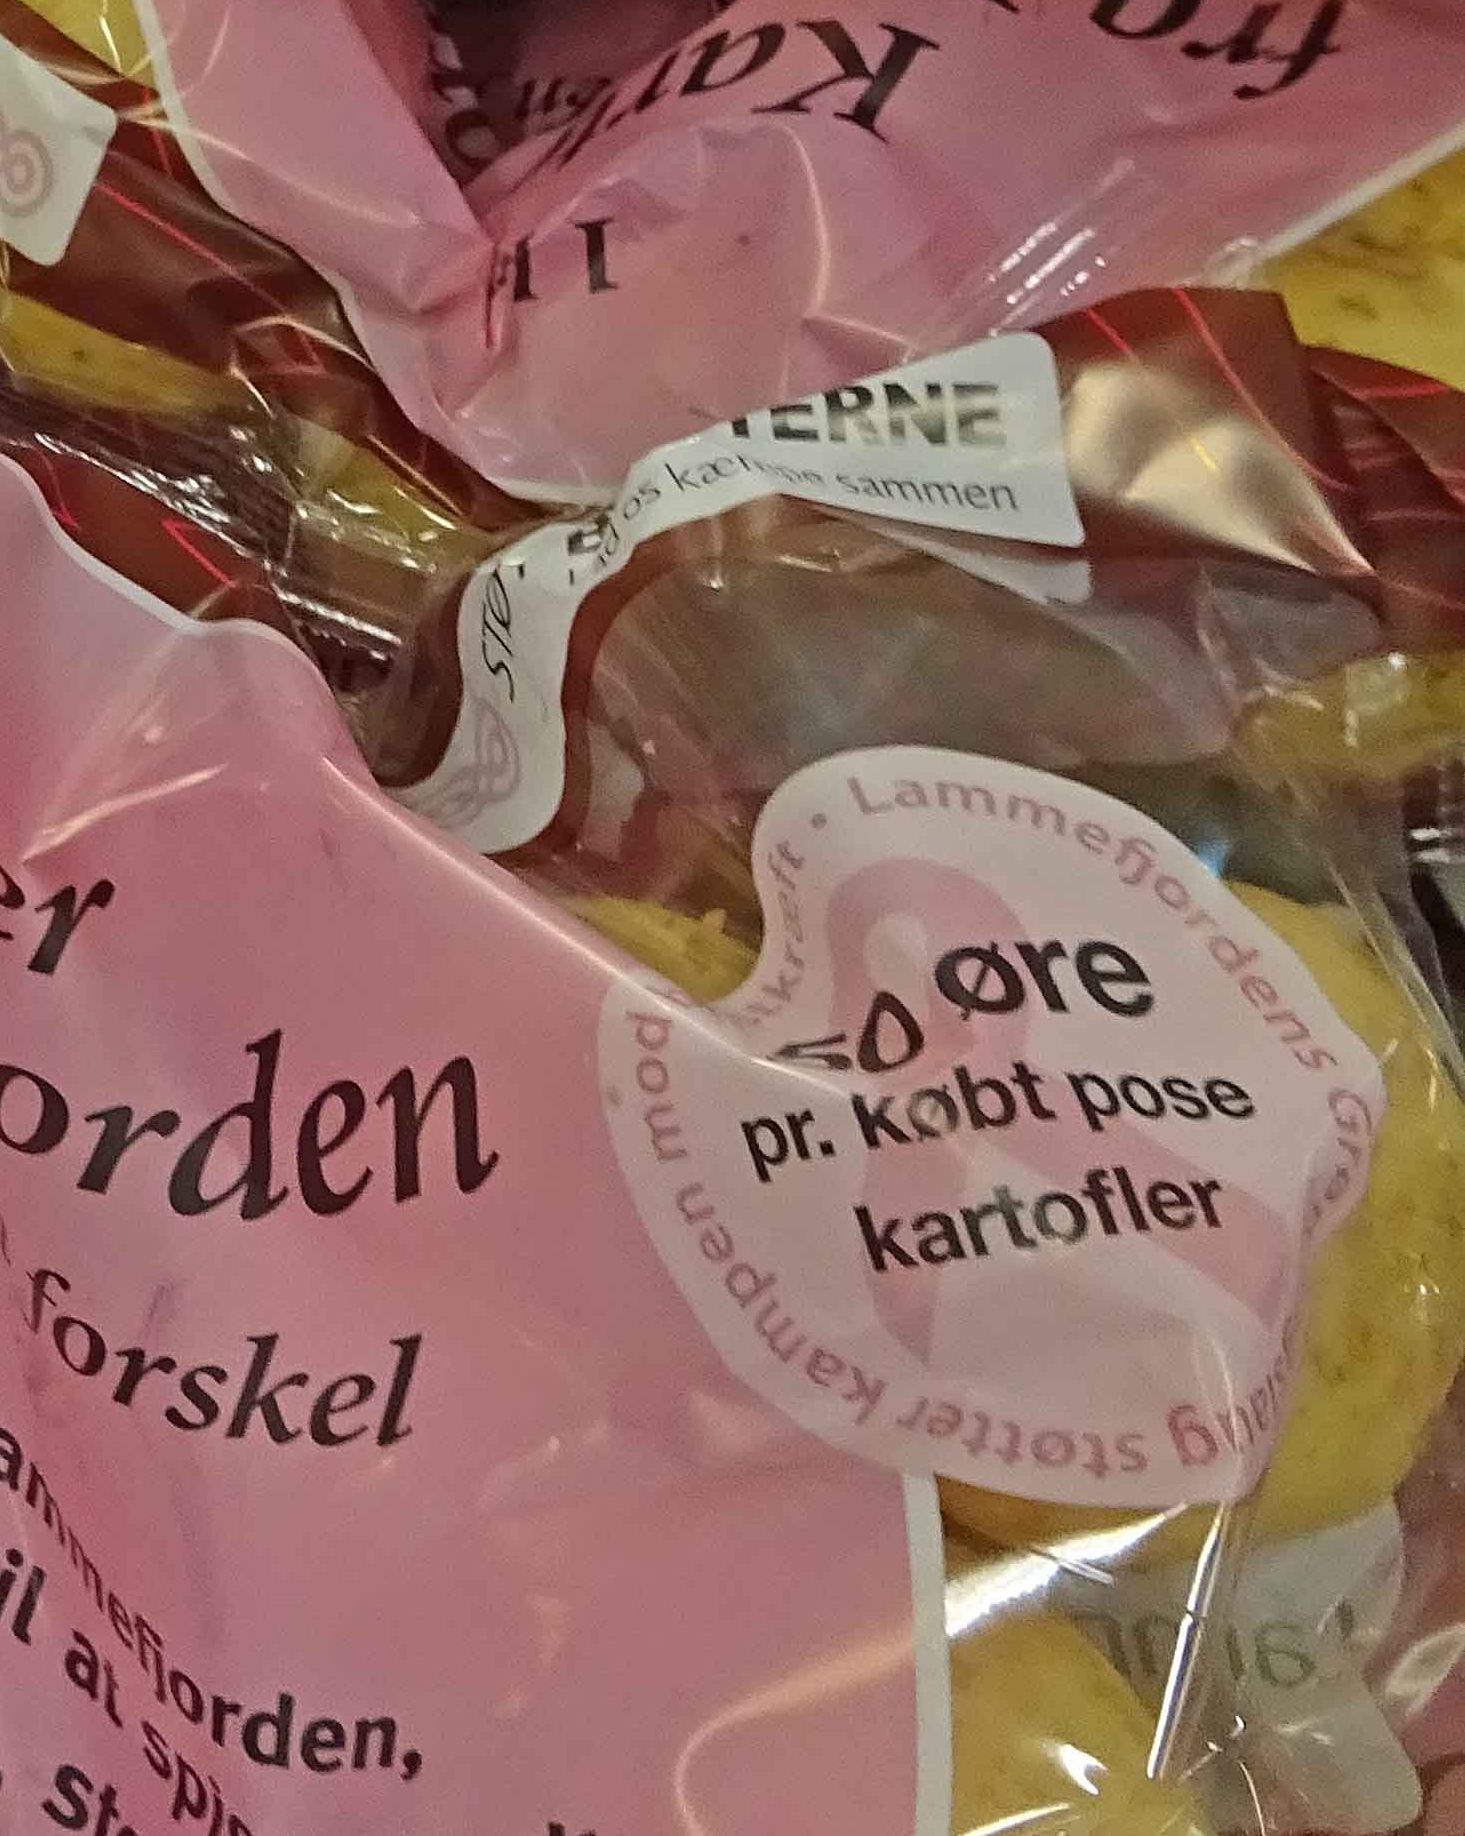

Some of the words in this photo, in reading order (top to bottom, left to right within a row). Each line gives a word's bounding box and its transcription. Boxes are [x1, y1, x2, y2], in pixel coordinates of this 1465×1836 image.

[622, 481, 662, 523] os
[834, 466, 1019, 512] sammen
[846, 773, 1337, 1076] Lammefjordens
[932, 932, 1155, 1023] øre
[626, 1009, 689, 1163] mod
[740, 1108, 837, 1185] pr.
[851, 1060, 1056, 1154] købt
[1065, 1067, 1256, 1132] pose
[852, 1168, 1226, 1274] kartofler
[22, 1267, 424, 1450] forskel
[673, 1178, 877, 1430] kampen
[897, 1386, 1150, 1477] støtter
[64, 1627, 125, 1729] at
